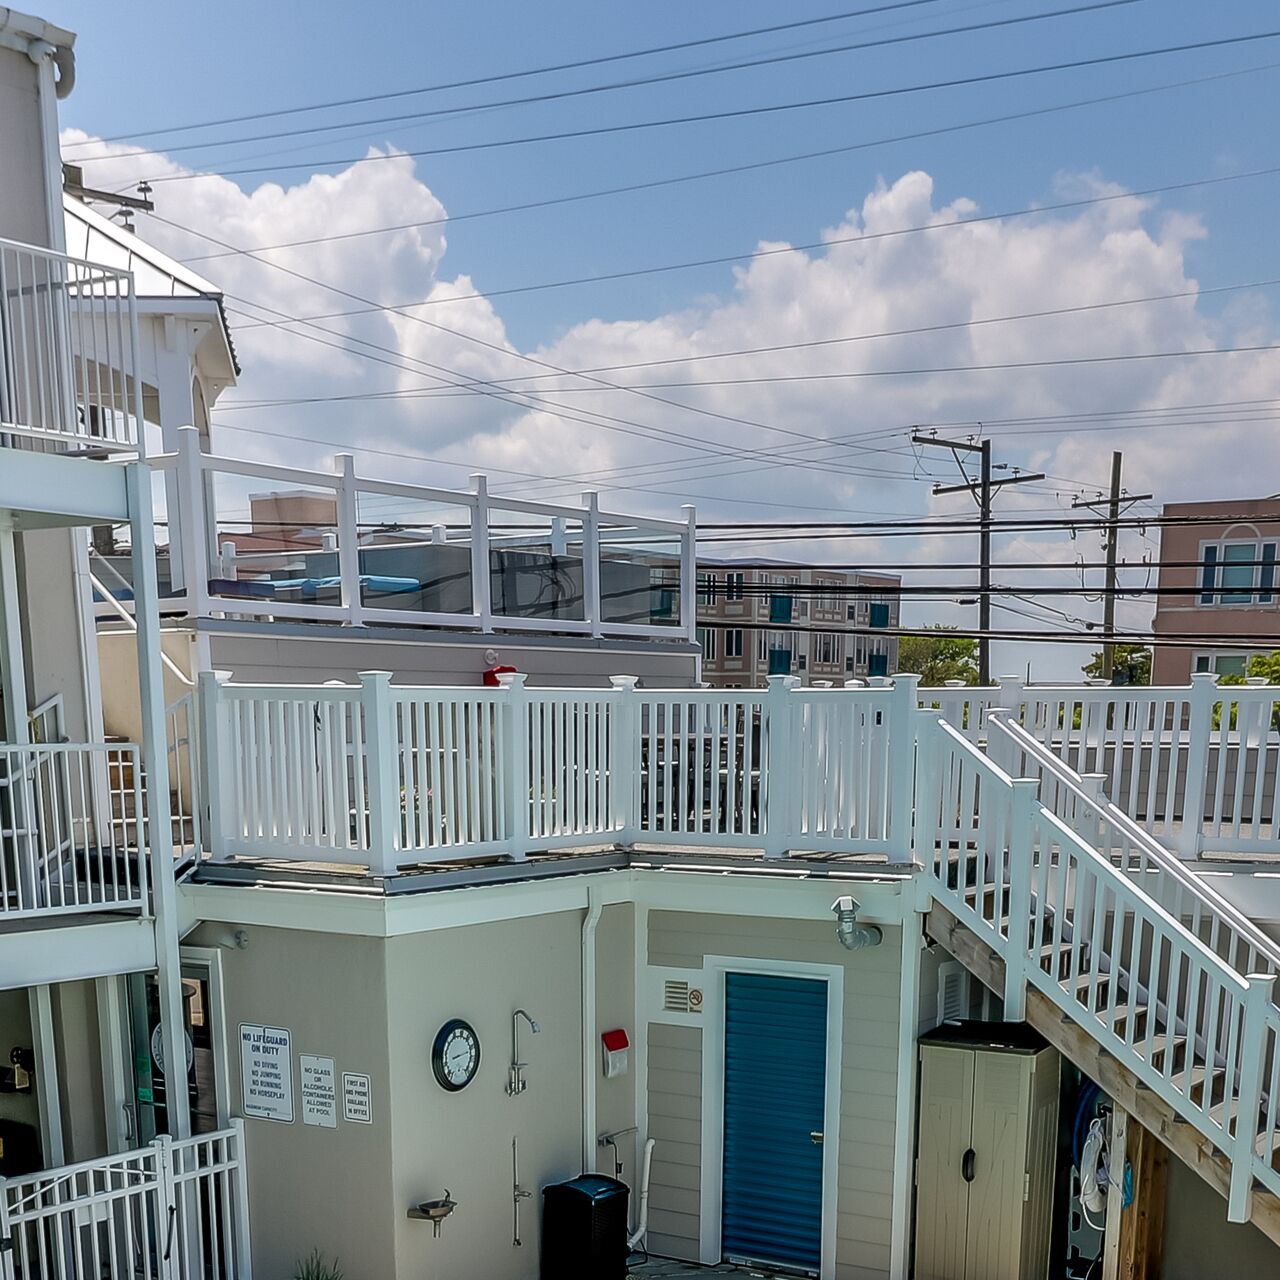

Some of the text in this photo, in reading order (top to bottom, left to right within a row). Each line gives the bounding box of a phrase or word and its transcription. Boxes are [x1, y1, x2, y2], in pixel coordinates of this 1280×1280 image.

[242, 1033, 251, 1042] NO
[251, 1044, 279, 1055] ON DUTY
[253, 1060, 278, 1070] NO DIVING
[260, 1071, 281, 1080] JUMPING
[313, 1068, 330, 1076] GLASS
[260, 1081, 281, 1090] RUNNING
[304, 1083, 333, 1092] ALCOHOLIC
[249, 1088, 285, 1099] NO HORSEPLAY
[303, 1091, 335, 1100] CONTAINERS
[307, 1099, 332, 1108] ALLOWED
[316, 1108, 330, 1116] POOL
[353, 1108, 367, 1116] OFFICE
